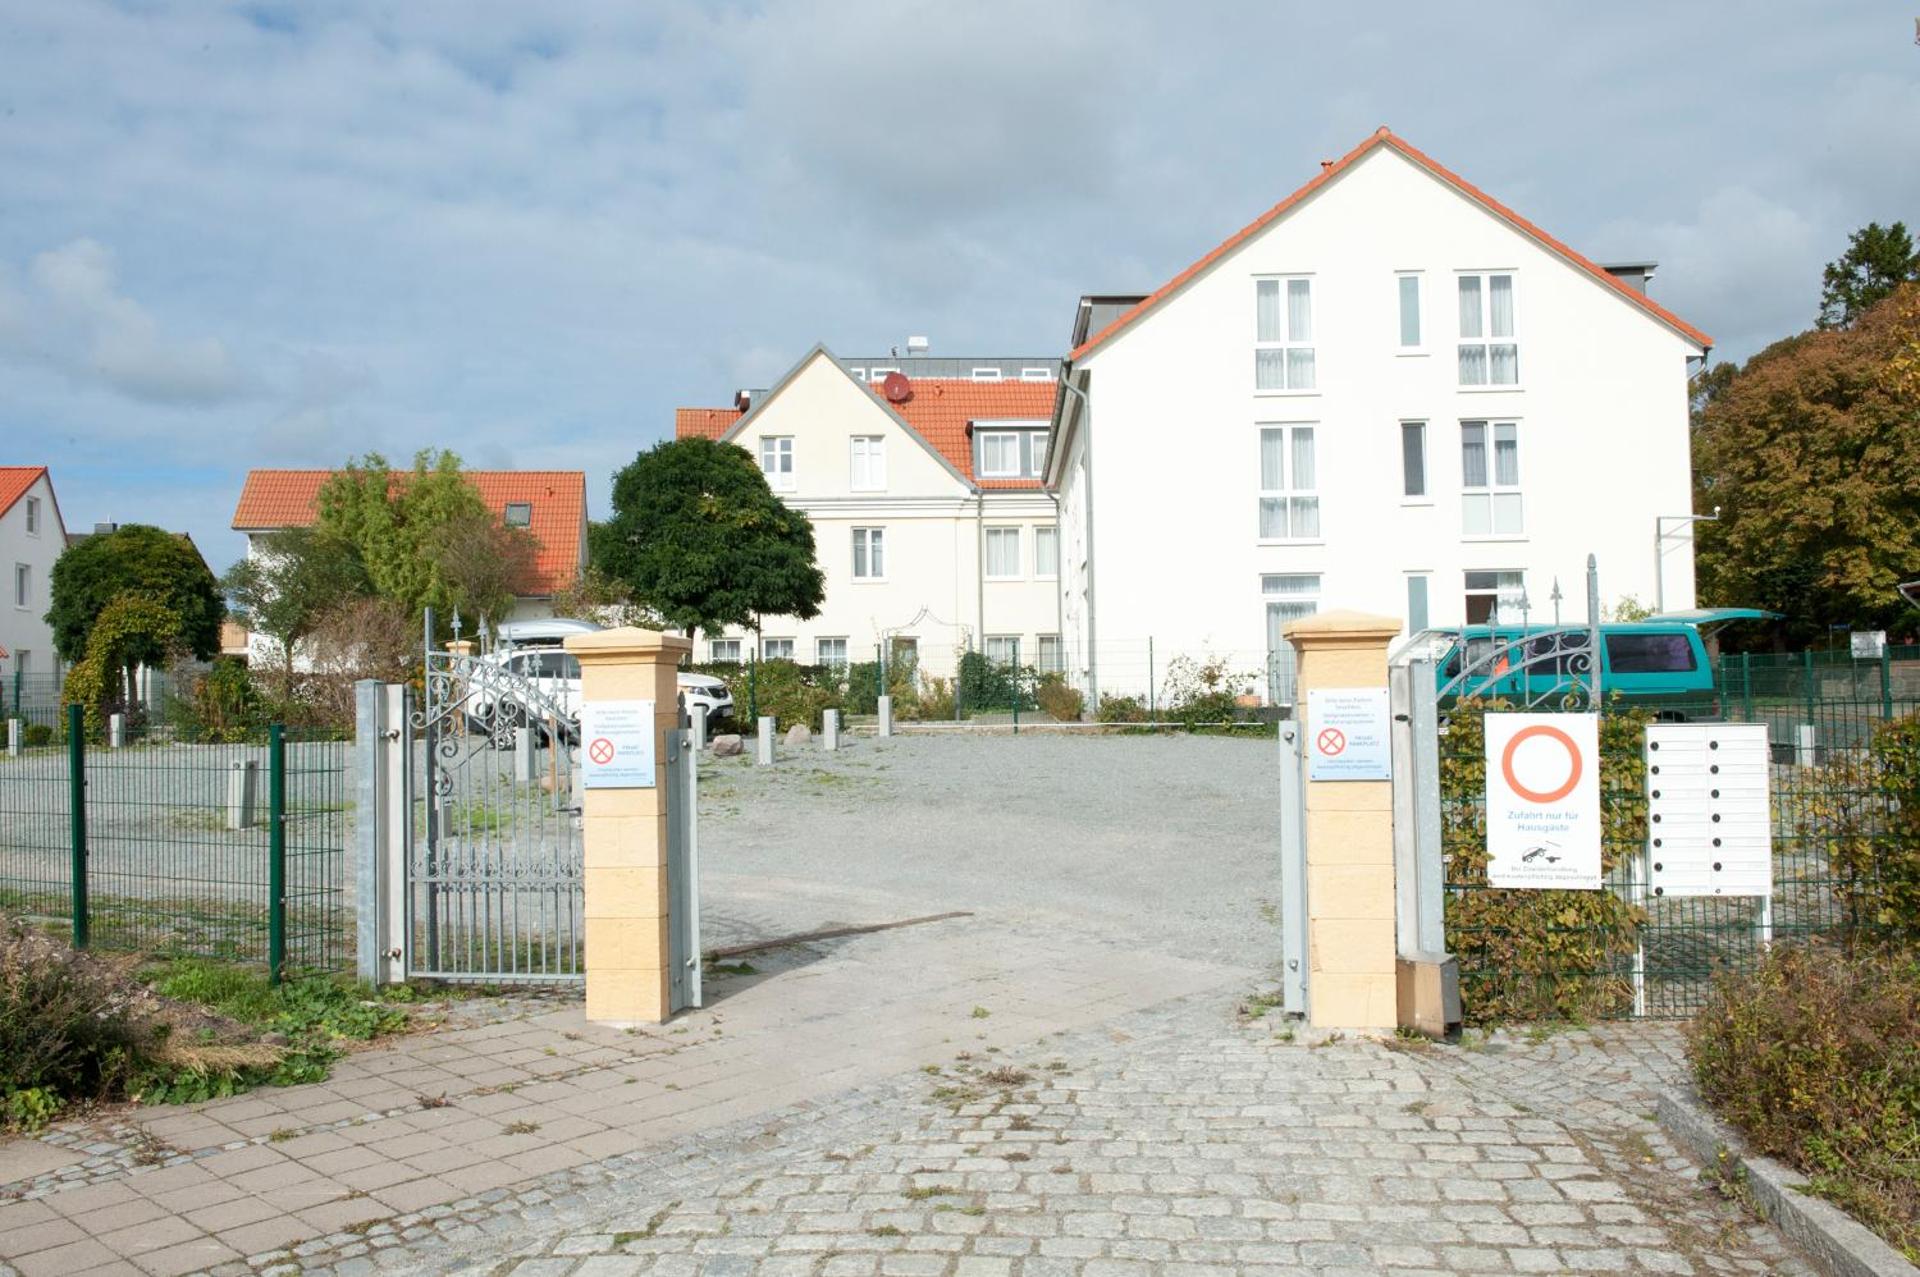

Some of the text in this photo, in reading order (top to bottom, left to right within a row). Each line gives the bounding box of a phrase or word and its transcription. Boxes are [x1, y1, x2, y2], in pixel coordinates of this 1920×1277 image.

[1507, 810, 1579, 820] Zufahrt nur für
[1517, 823, 1569, 834] Hausgäste
